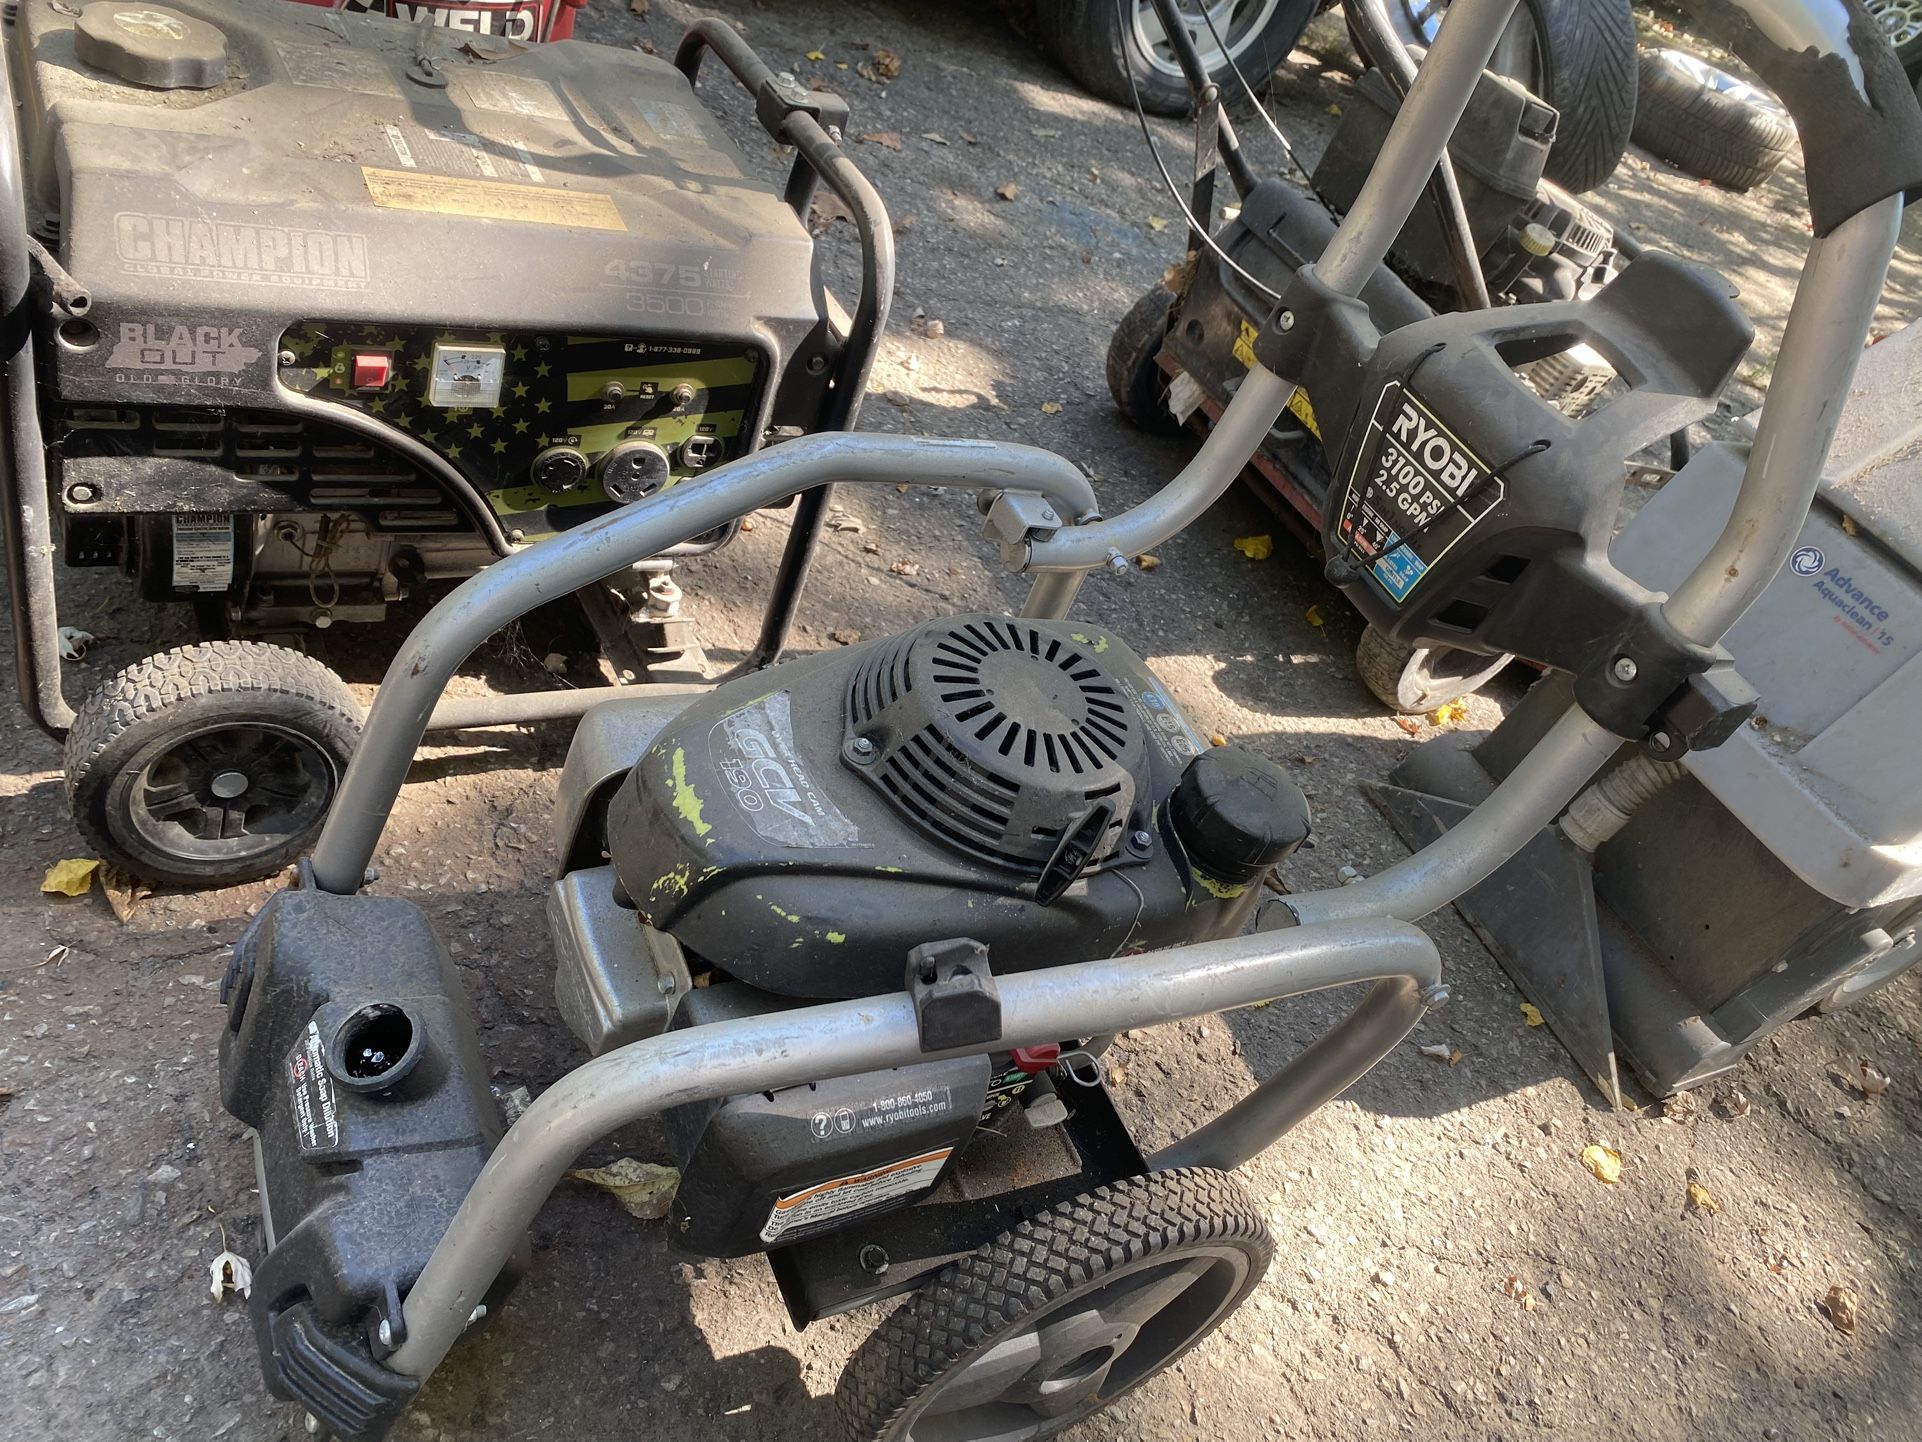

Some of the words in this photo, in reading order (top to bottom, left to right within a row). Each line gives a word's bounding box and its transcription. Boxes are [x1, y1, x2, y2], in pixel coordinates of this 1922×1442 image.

[117, 215, 367, 278] CHAMPION
[123, 264, 194, 276] GLOBAL
[201, 269, 263, 282] POWER
[271, 274, 367, 289] EQUIPMENT
[604, 259, 702, 287] 4375
[626, 292, 704, 316] 3500
[119, 322, 245, 350] BLACK
[140, 348, 226, 367] OUT
[115, 373, 152, 384] OLD
[181, 376, 243, 387] GLORY
[1392, 402, 1478, 497] RYOBI
[1375, 470, 1401, 498] 2.5
[1381, 447, 1425, 495] 3100
[1419, 490, 1445, 515] PSI
[1823, 567, 1889, 622] Advance
[1812, 580, 1873, 631] Aquaclean
[1878, 631, 1895, 646] 15
[719, 758, 764, 812] 190
[735, 728, 817, 827] GCV
[788, 758, 810, 789] HEAD
[806, 791, 826, 817] CAM
[317, 1078, 328, 1101] Soap
[872, 1090, 933, 1113] 1-800-860-4050
[321, 1099, 335, 1138] Dilution
[861, 1100, 946, 1128] www.ryobitools.com
